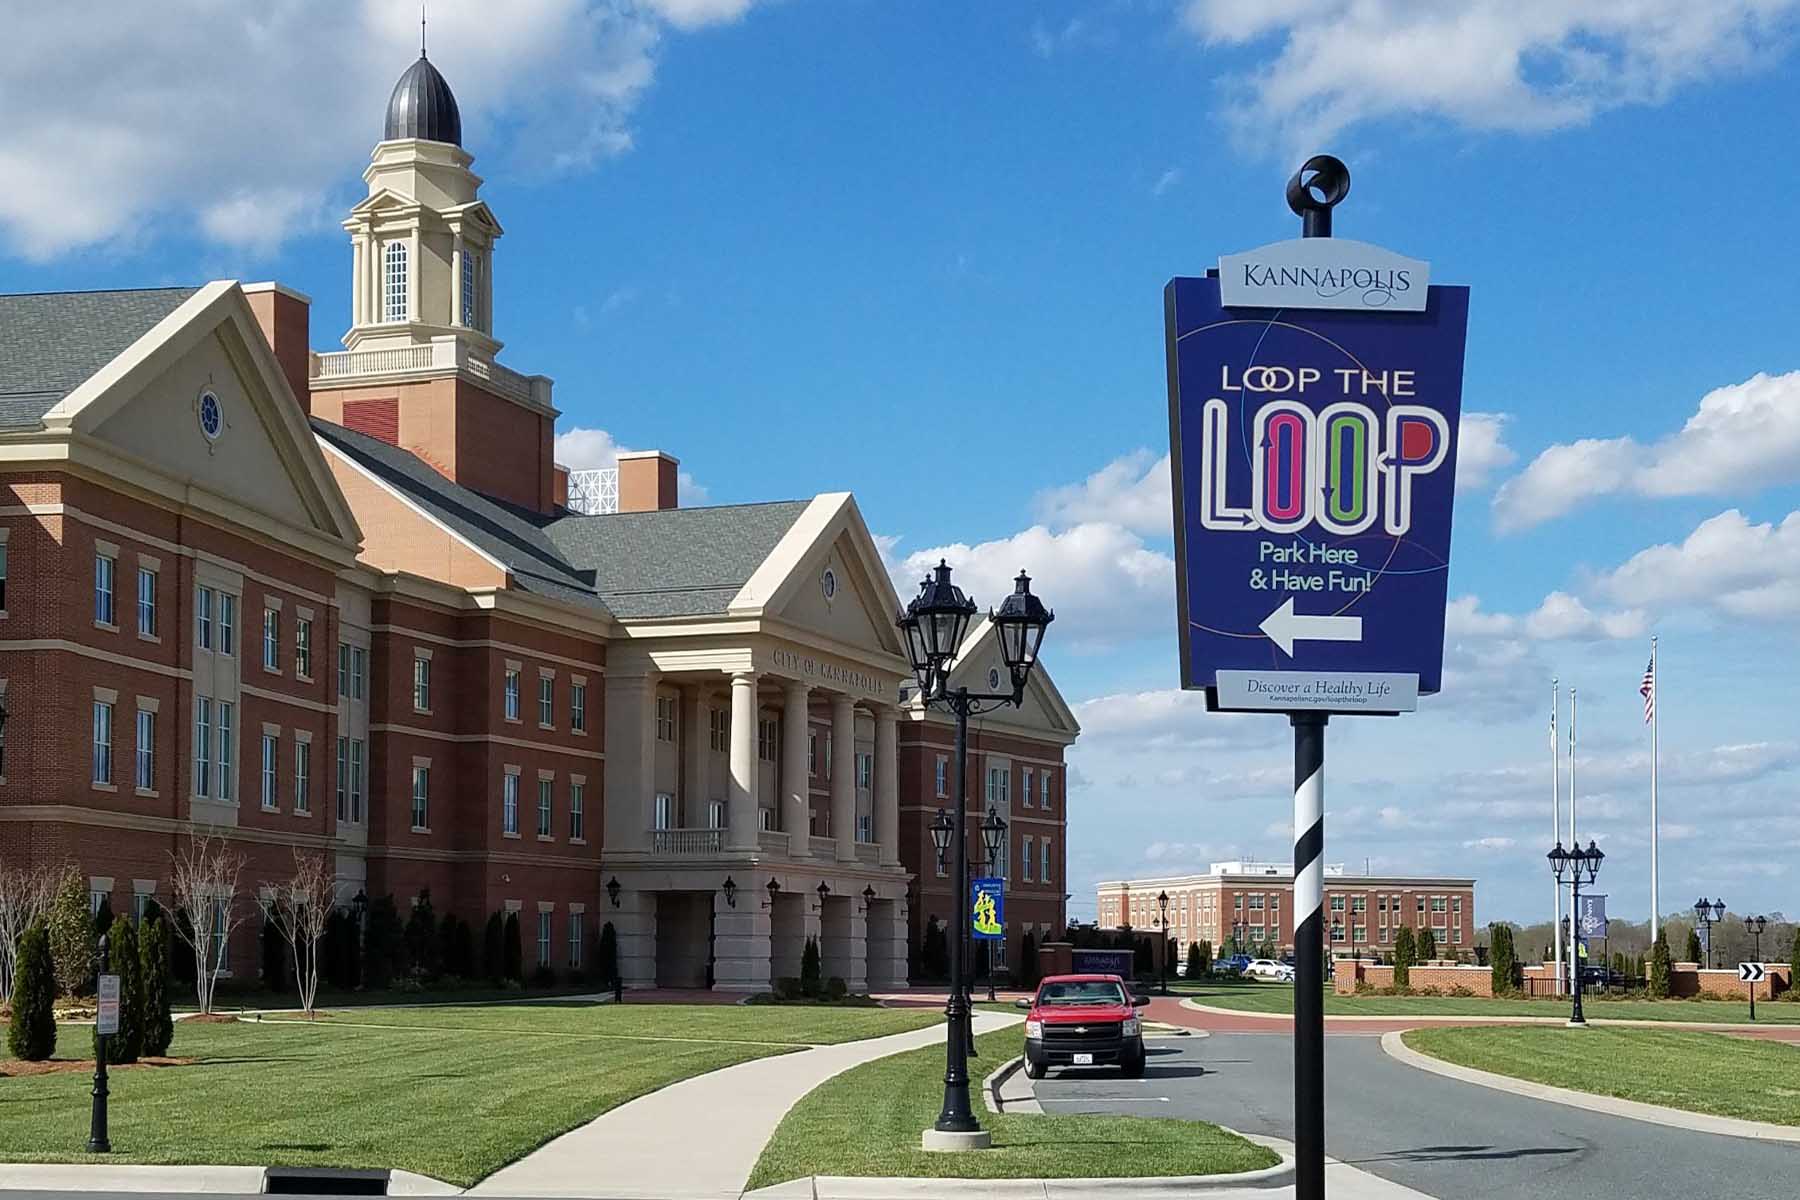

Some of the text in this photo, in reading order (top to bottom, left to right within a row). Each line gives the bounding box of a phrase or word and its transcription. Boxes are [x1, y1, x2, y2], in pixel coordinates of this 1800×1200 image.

[1243, 264, 1411, 295] KANNAPOLIS
[1222, 365, 1416, 396] LOOP THE
[1202, 398, 1450, 536] LOOP
[1259, 541, 1359, 564] Park Here
[1250, 569, 1371, 592] & Have Fun!
[773, 649, 800, 670] CITY
[804, 658, 815, 673] OF
[1247, 679, 1391, 697] Discover a Healthy Life
